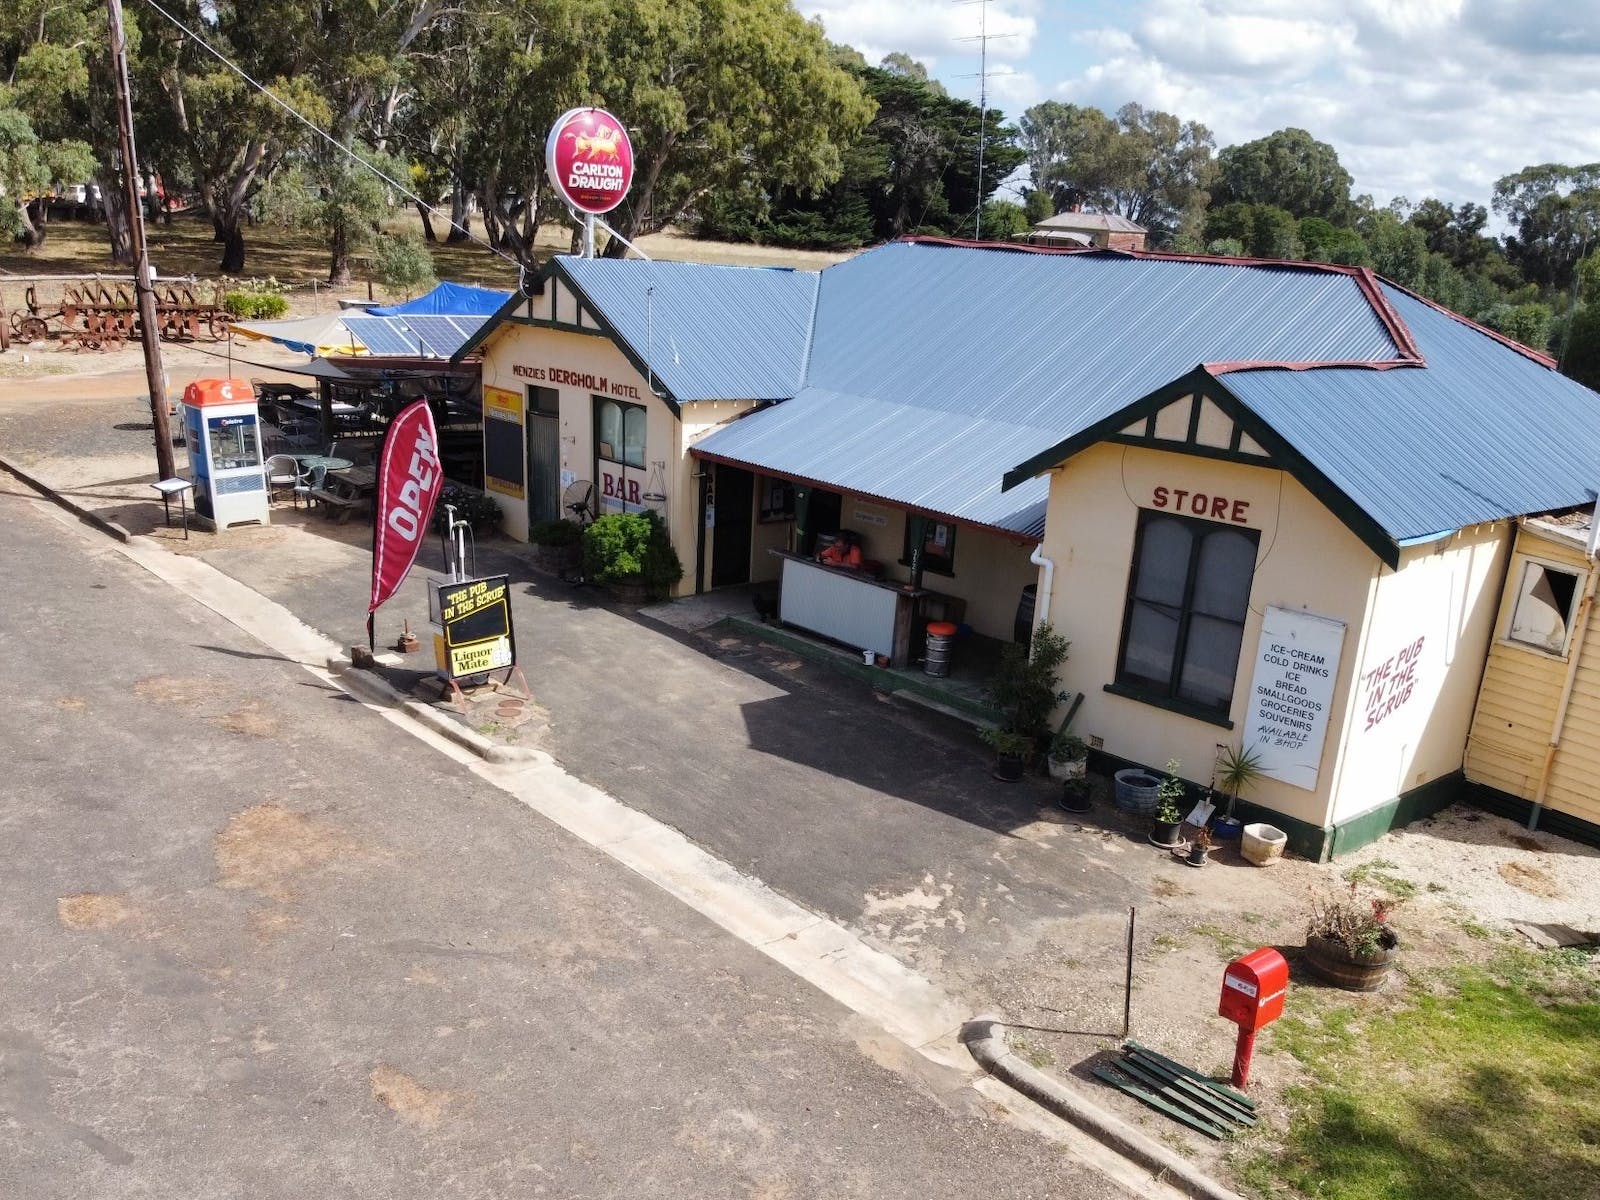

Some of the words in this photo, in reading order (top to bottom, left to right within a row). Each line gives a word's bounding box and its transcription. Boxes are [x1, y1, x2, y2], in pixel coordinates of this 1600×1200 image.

[572, 161, 622, 178] CARLTON
[568, 174, 624, 191] DRAUGHT
[513, 364, 546, 380] MENZIES
[549, 367, 608, 392] DERGHOLM
[611, 382, 641, 400] HOTEL
[389, 423, 438, 542] OPEN
[603, 472, 641, 505] BAR
[1152, 486, 1250, 524] STORE
[469, 581, 488, 598] PUB
[444, 606, 455, 619] IN
[457, 598, 475, 615] THE
[476, 584, 506, 607] SCRUB"
[454, 647, 493, 662] Liquor
[1270, 644, 1325, 665] ICE-CREAM
[1395, 635, 1425, 671] PUB
[458, 658, 489, 672] Mate
[1263, 653, 1289, 667] COLD
[1292, 661, 1329, 678] DRINKS
[1285, 671, 1302, 682] ICE
[1275, 680, 1307, 696] BREAD
[1365, 681, 1386, 712] IN
[1388, 660, 1417, 695] THE
[1257, 685, 1322, 712] SMALLGOODS
[1260, 698, 1315, 721] GROCERIES
[1259, 709, 1313, 732] SOUVENIRS
[1257, 725, 1309, 742] AVAILABLE
[1260, 735, 1270, 744] IN
[1274, 738, 1304, 750] SHOP
